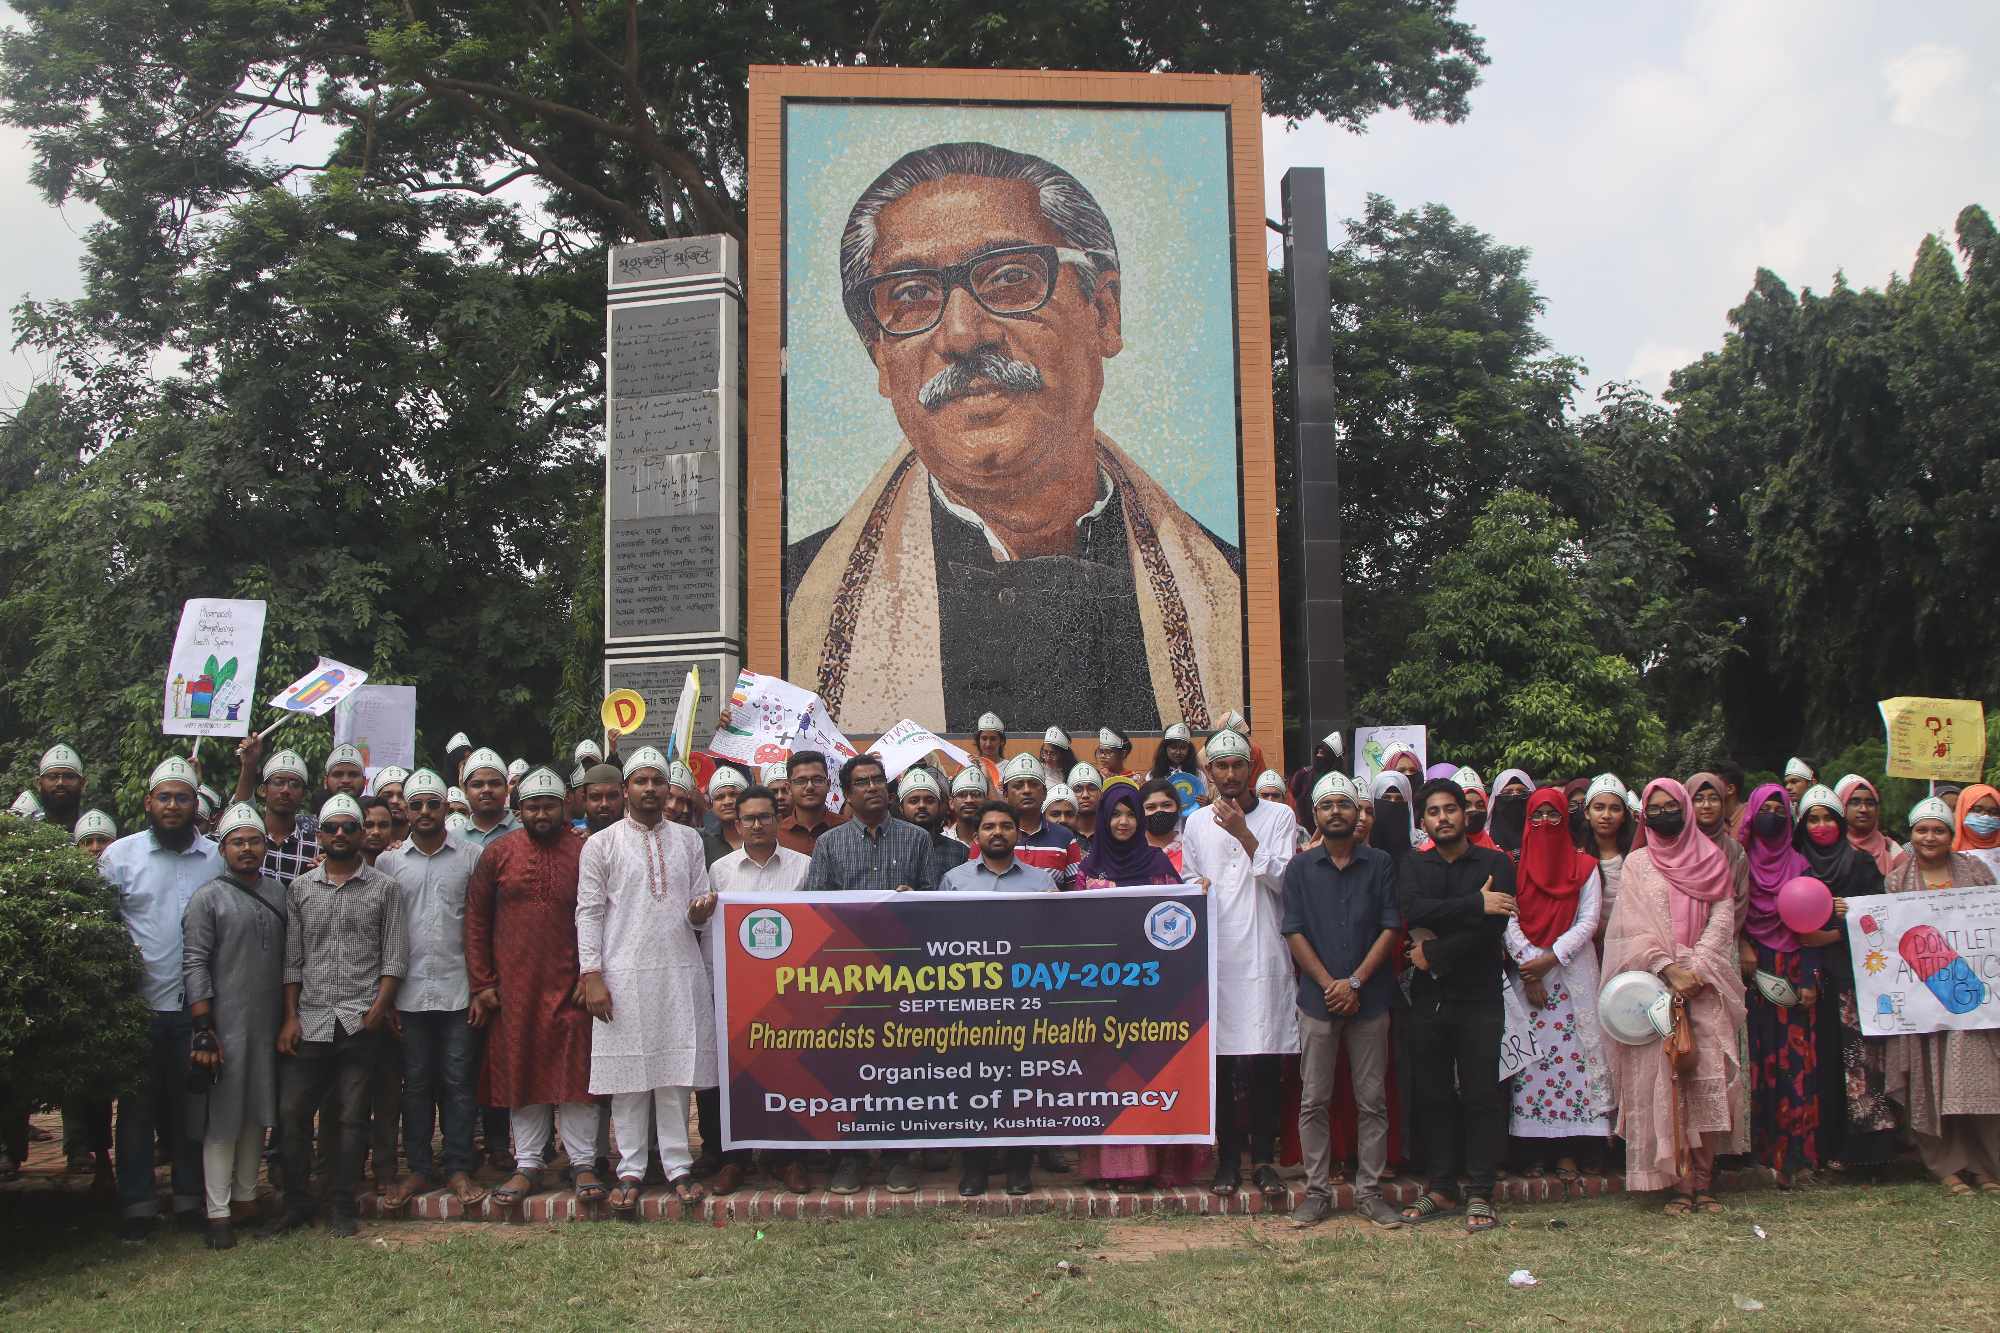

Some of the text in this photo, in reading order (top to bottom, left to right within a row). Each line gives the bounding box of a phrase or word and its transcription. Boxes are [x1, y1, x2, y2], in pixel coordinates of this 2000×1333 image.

[927, 940, 1011, 957] WORLD
[1965, 927, 1996, 949] LET
[775, 961, 1161, 995] PHARMACISTS DAY-2023
[1896, 955, 2000, 984] ANTIBIOTIC
[899, 997, 1042, 1013] SEPTEMBER 25
[749, 1015, 1190, 1053] Pharmacists Strengthening Health Systems
[859, 1060, 1083, 1083] Organised by: BPSA
[765, 1087, 1179, 1115] Department of Pharmacy
[837, 1115, 1105, 1132] Islamic University, Kushtia-7003.
